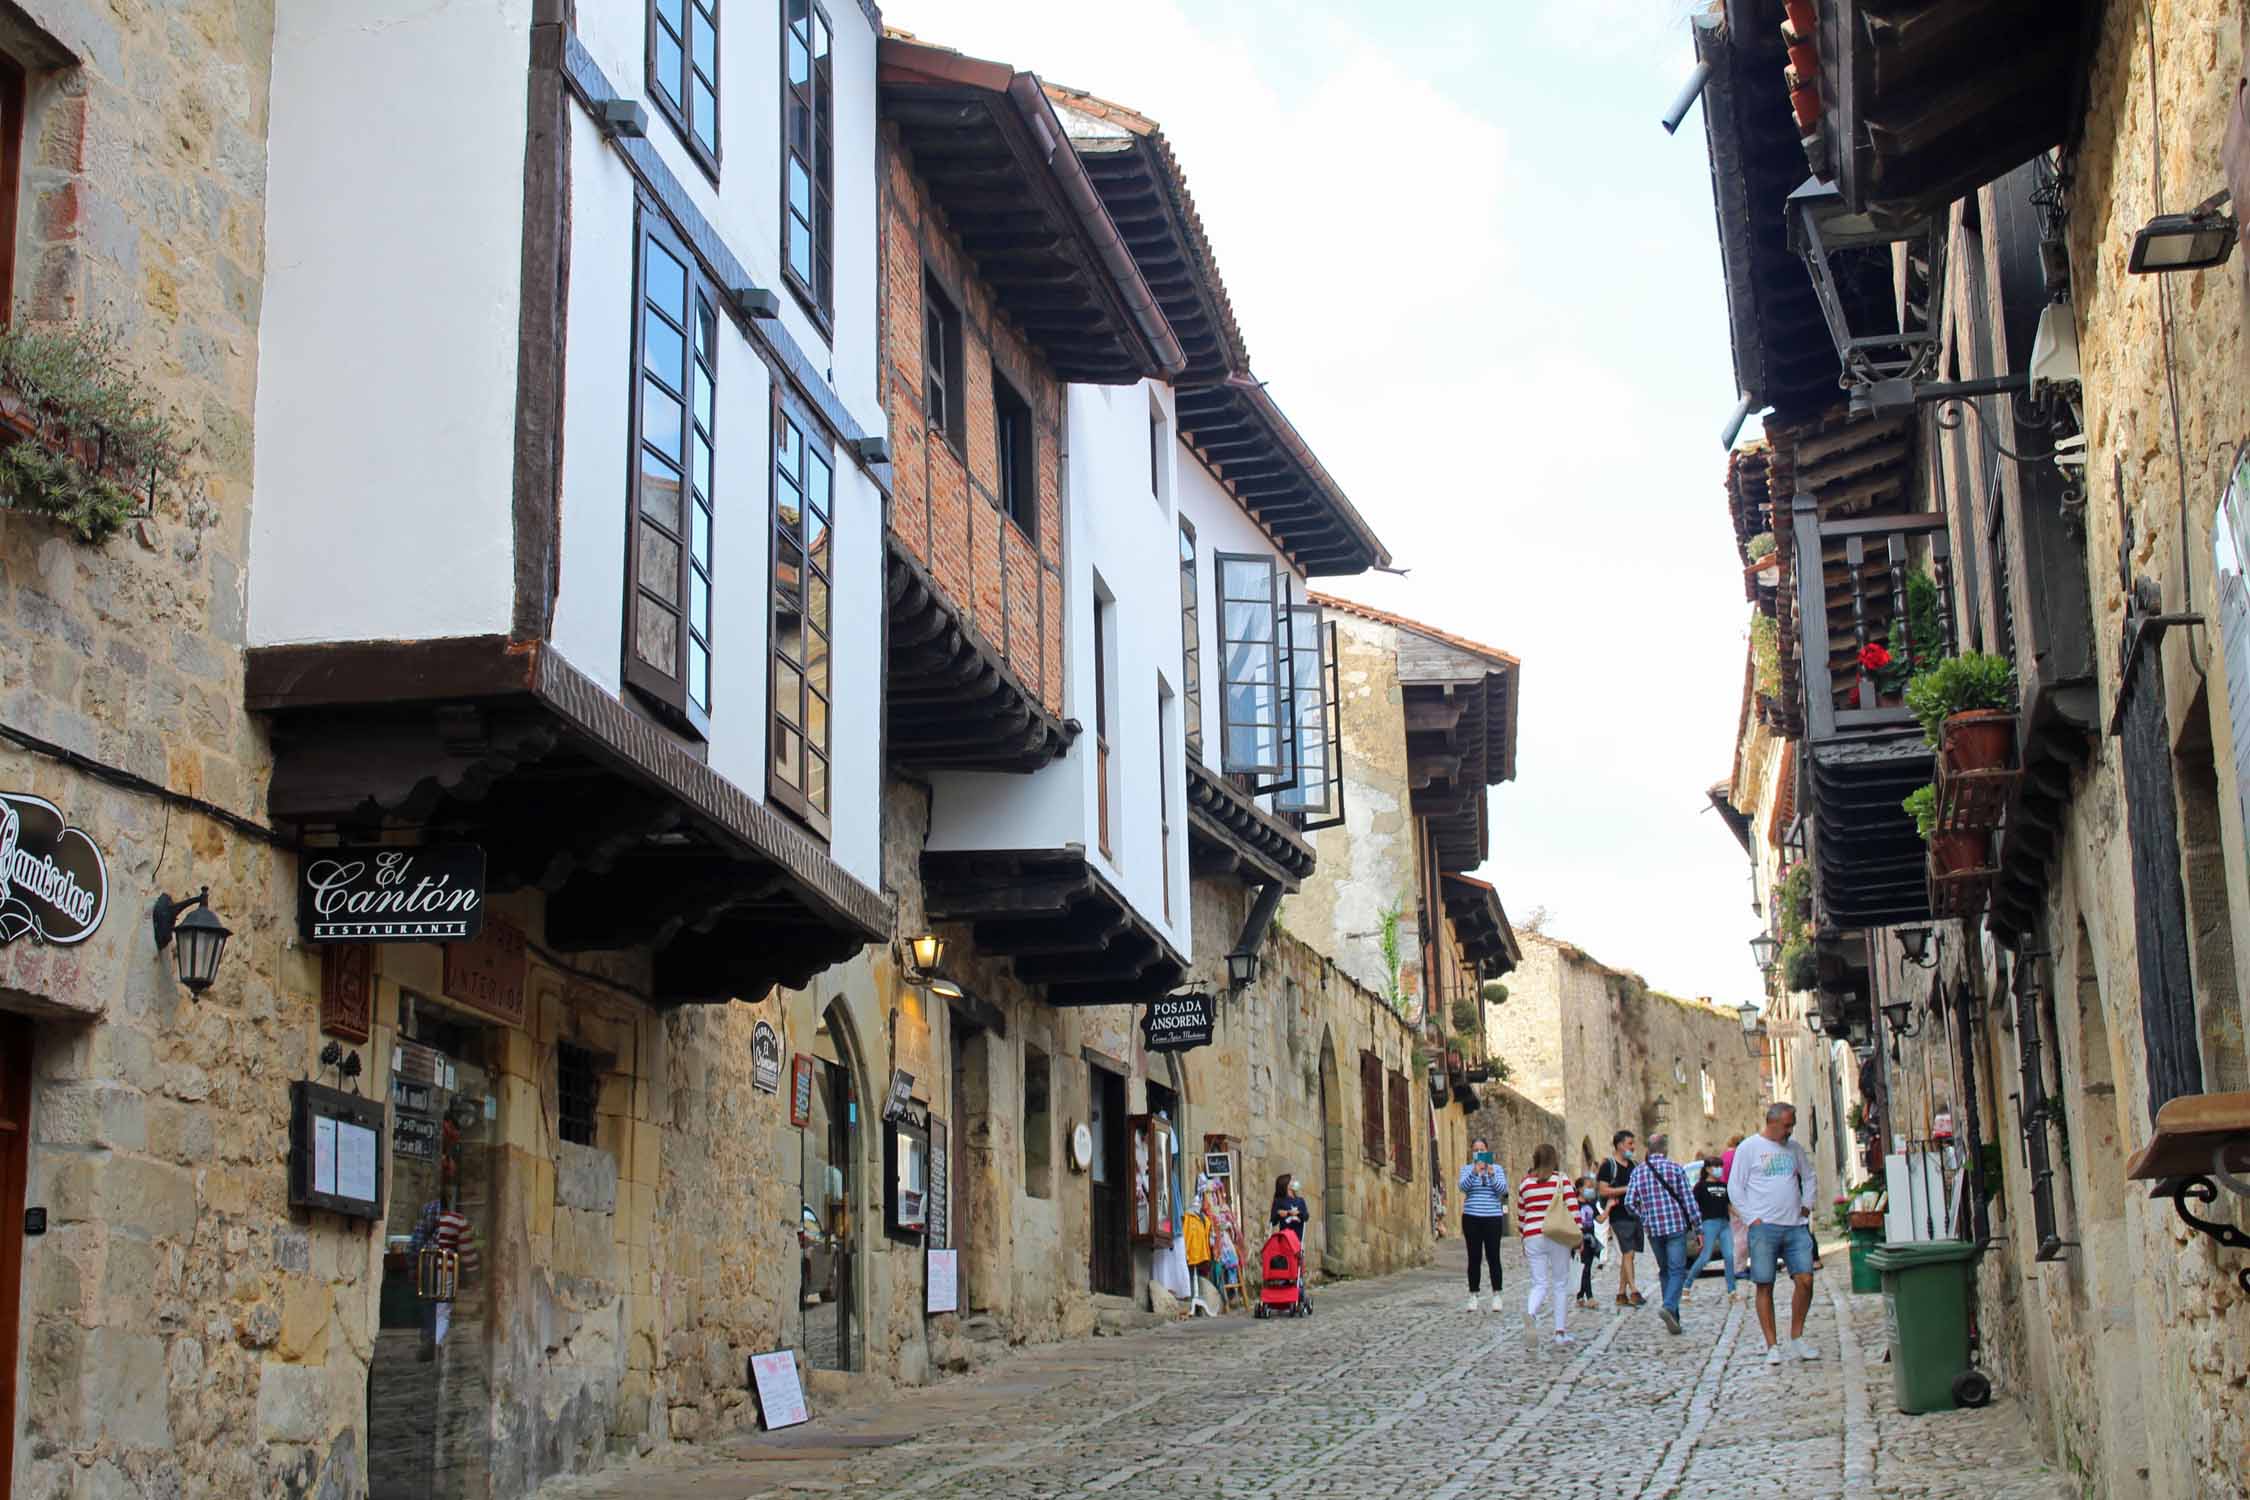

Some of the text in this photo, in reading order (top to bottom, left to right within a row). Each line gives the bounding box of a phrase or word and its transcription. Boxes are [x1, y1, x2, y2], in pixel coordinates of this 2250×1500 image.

[376, 852, 414, 889] El
[307, 860, 480, 920] Cantón
[314, 924, 466, 936] RESTAURANTE
[1154, 1000, 1201, 1015] POSADA
[1150, 1013, 1207, 1031] ANSORENA
